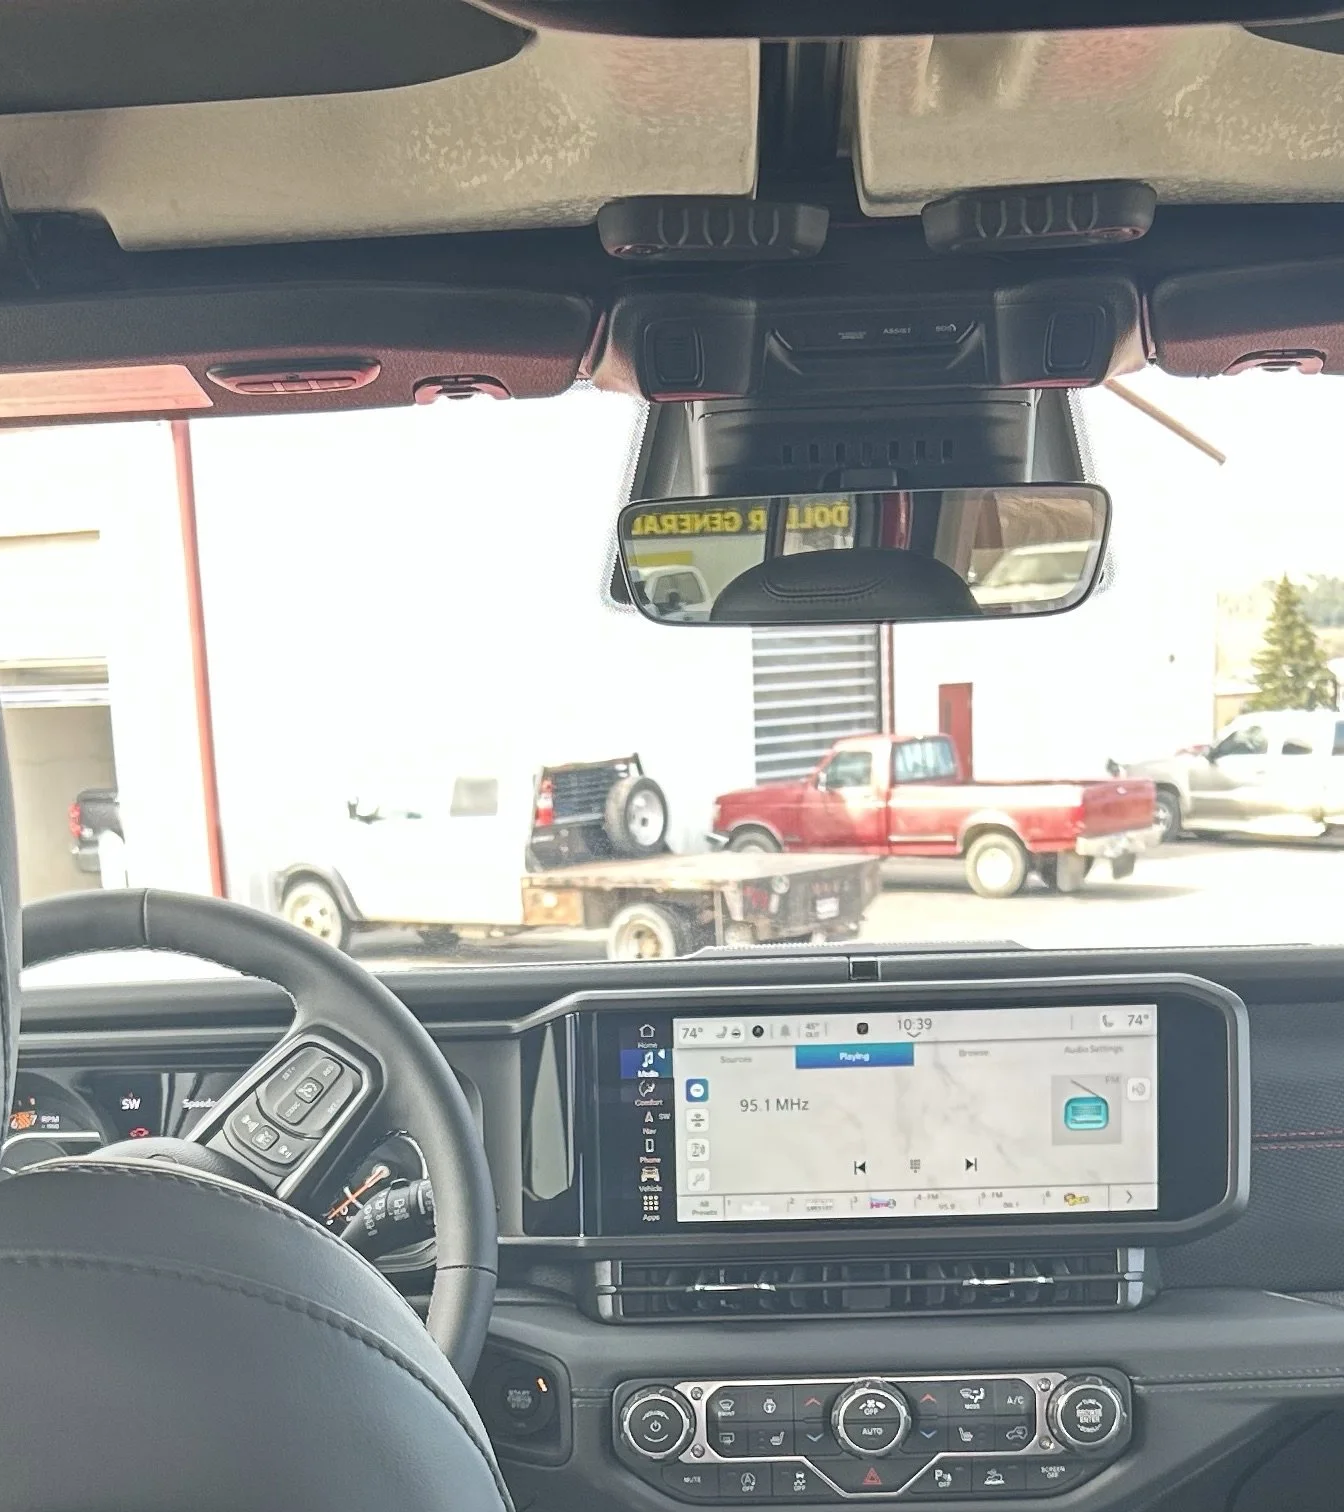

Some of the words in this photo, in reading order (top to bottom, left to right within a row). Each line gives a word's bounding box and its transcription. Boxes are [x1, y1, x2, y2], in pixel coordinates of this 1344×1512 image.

[897, 1018, 933, 1031] 10:39
[1127, 1014, 1149, 1026] 74°
[681, 1027, 704, 1040] 74°
[720, 1055, 753, 1064] Sources
[839, 1052, 870, 1063] Playing
[121, 1098, 141, 1110] SW
[739, 1099, 771, 1112] 95.1
[776, 1098, 810, 1111] MHz
[1007, 1396, 1025, 1405] A/C
[862, 1427, 884, 1436] AUTO
